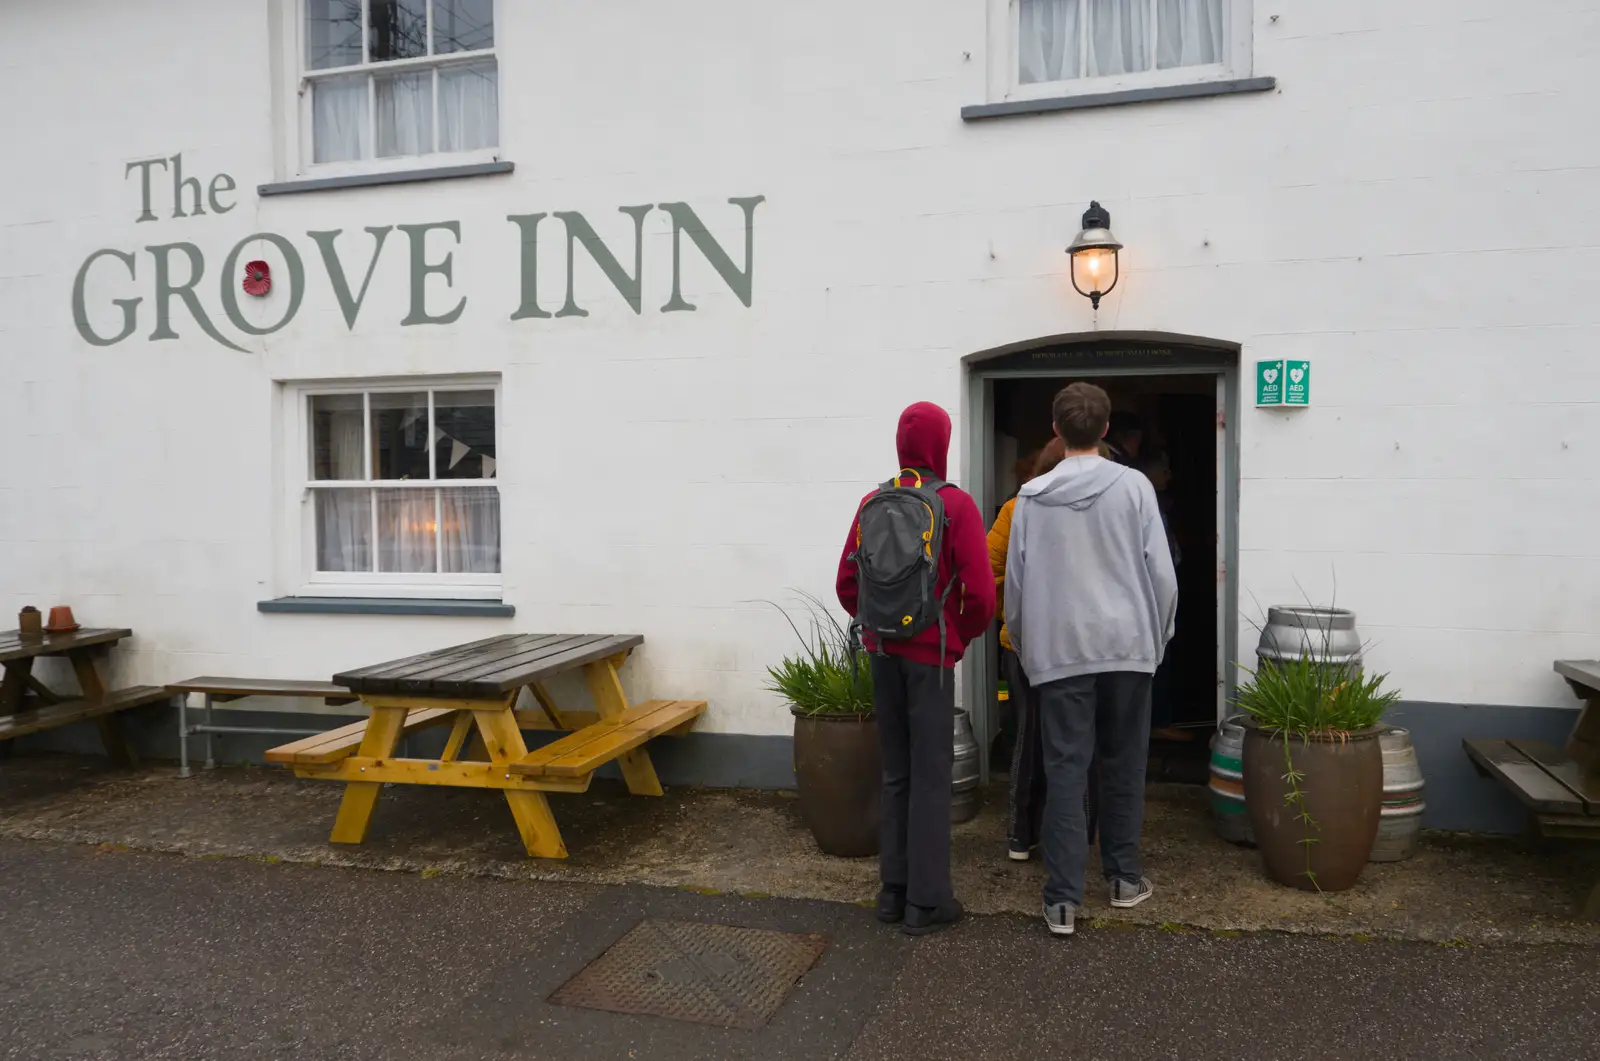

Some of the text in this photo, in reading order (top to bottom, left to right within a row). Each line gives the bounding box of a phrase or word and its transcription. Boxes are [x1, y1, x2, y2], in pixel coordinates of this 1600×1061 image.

[125, 153, 237, 223] The
[72, 195, 766, 353] GROVE INN
